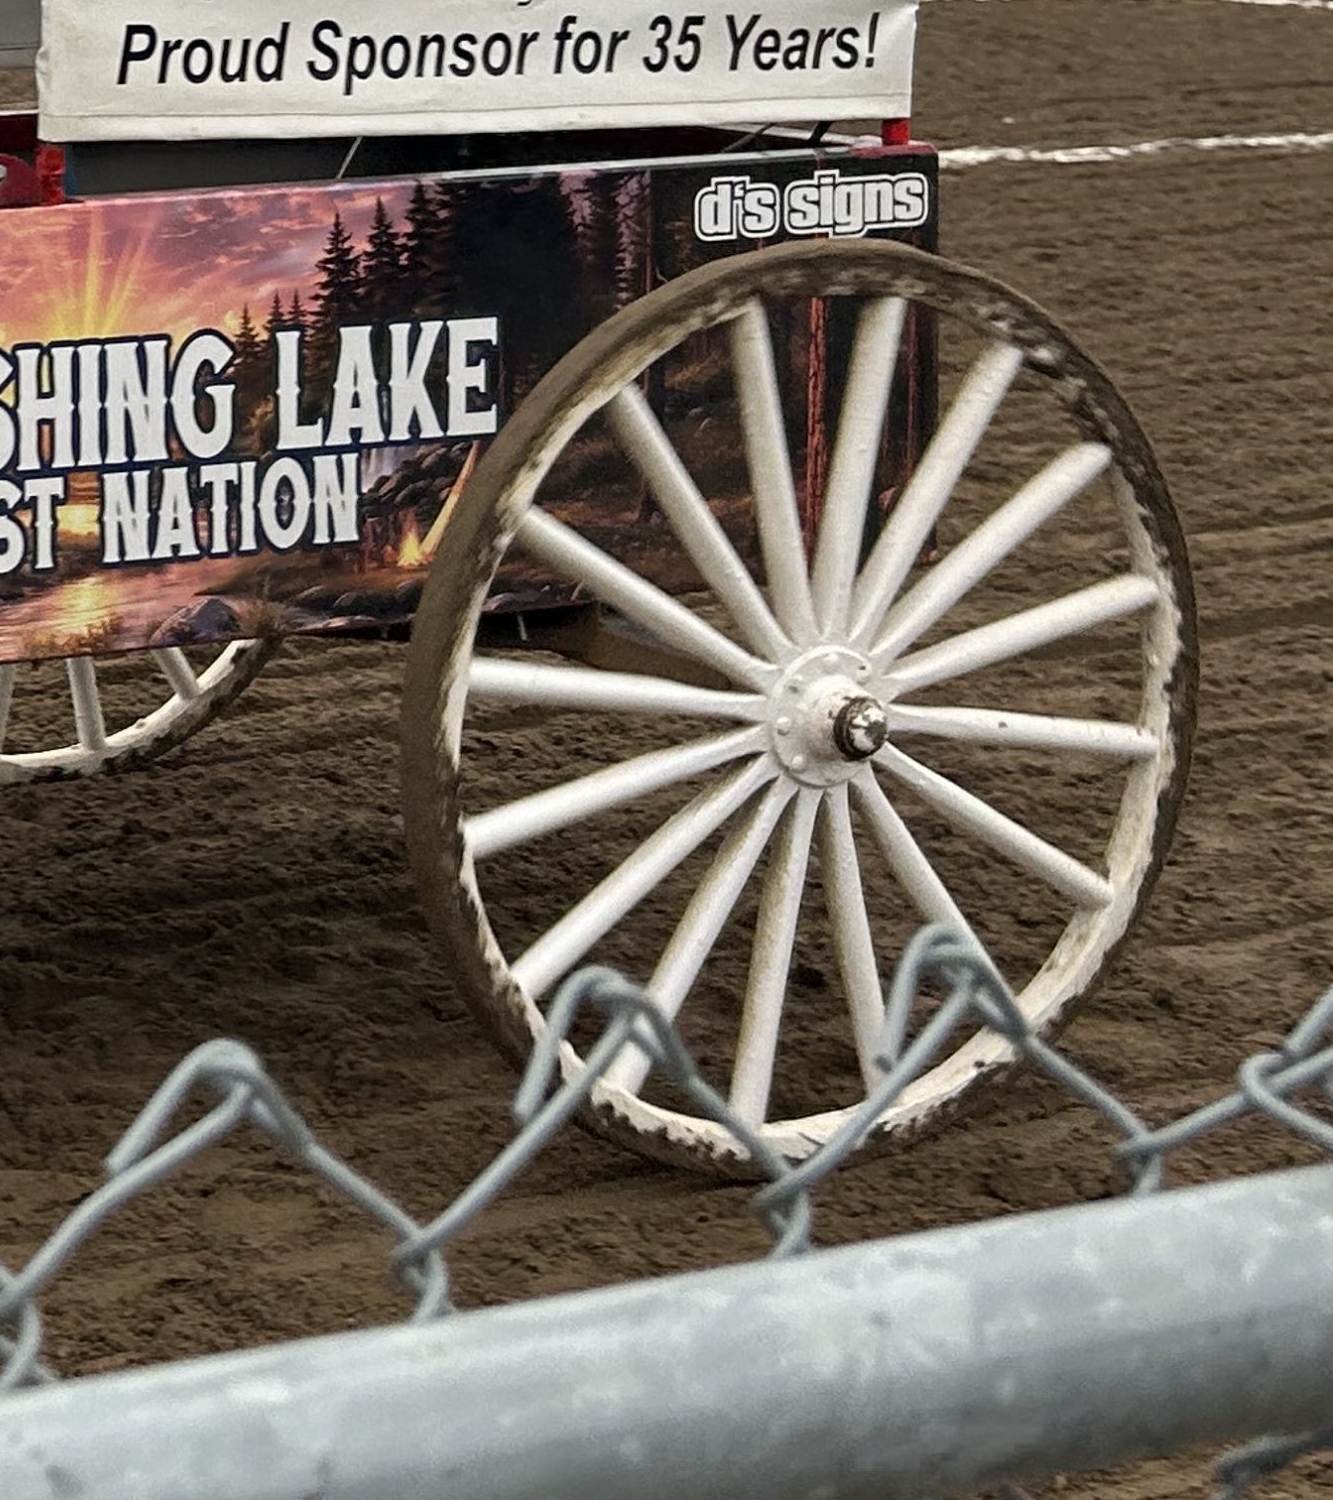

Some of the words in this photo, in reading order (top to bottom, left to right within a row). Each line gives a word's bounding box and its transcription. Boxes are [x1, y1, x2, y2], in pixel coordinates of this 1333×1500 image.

[116, 22, 290, 86] Proud
[306, 18, 539, 96] Sponsor
[553, 15, 629, 76] for
[642, 14, 705, 73] 35
[727, 12, 880, 75] Years!
[783, 169, 930, 239] signs
[273, 317, 500, 452] LAKE
[101, 451, 360, 567] NATION
